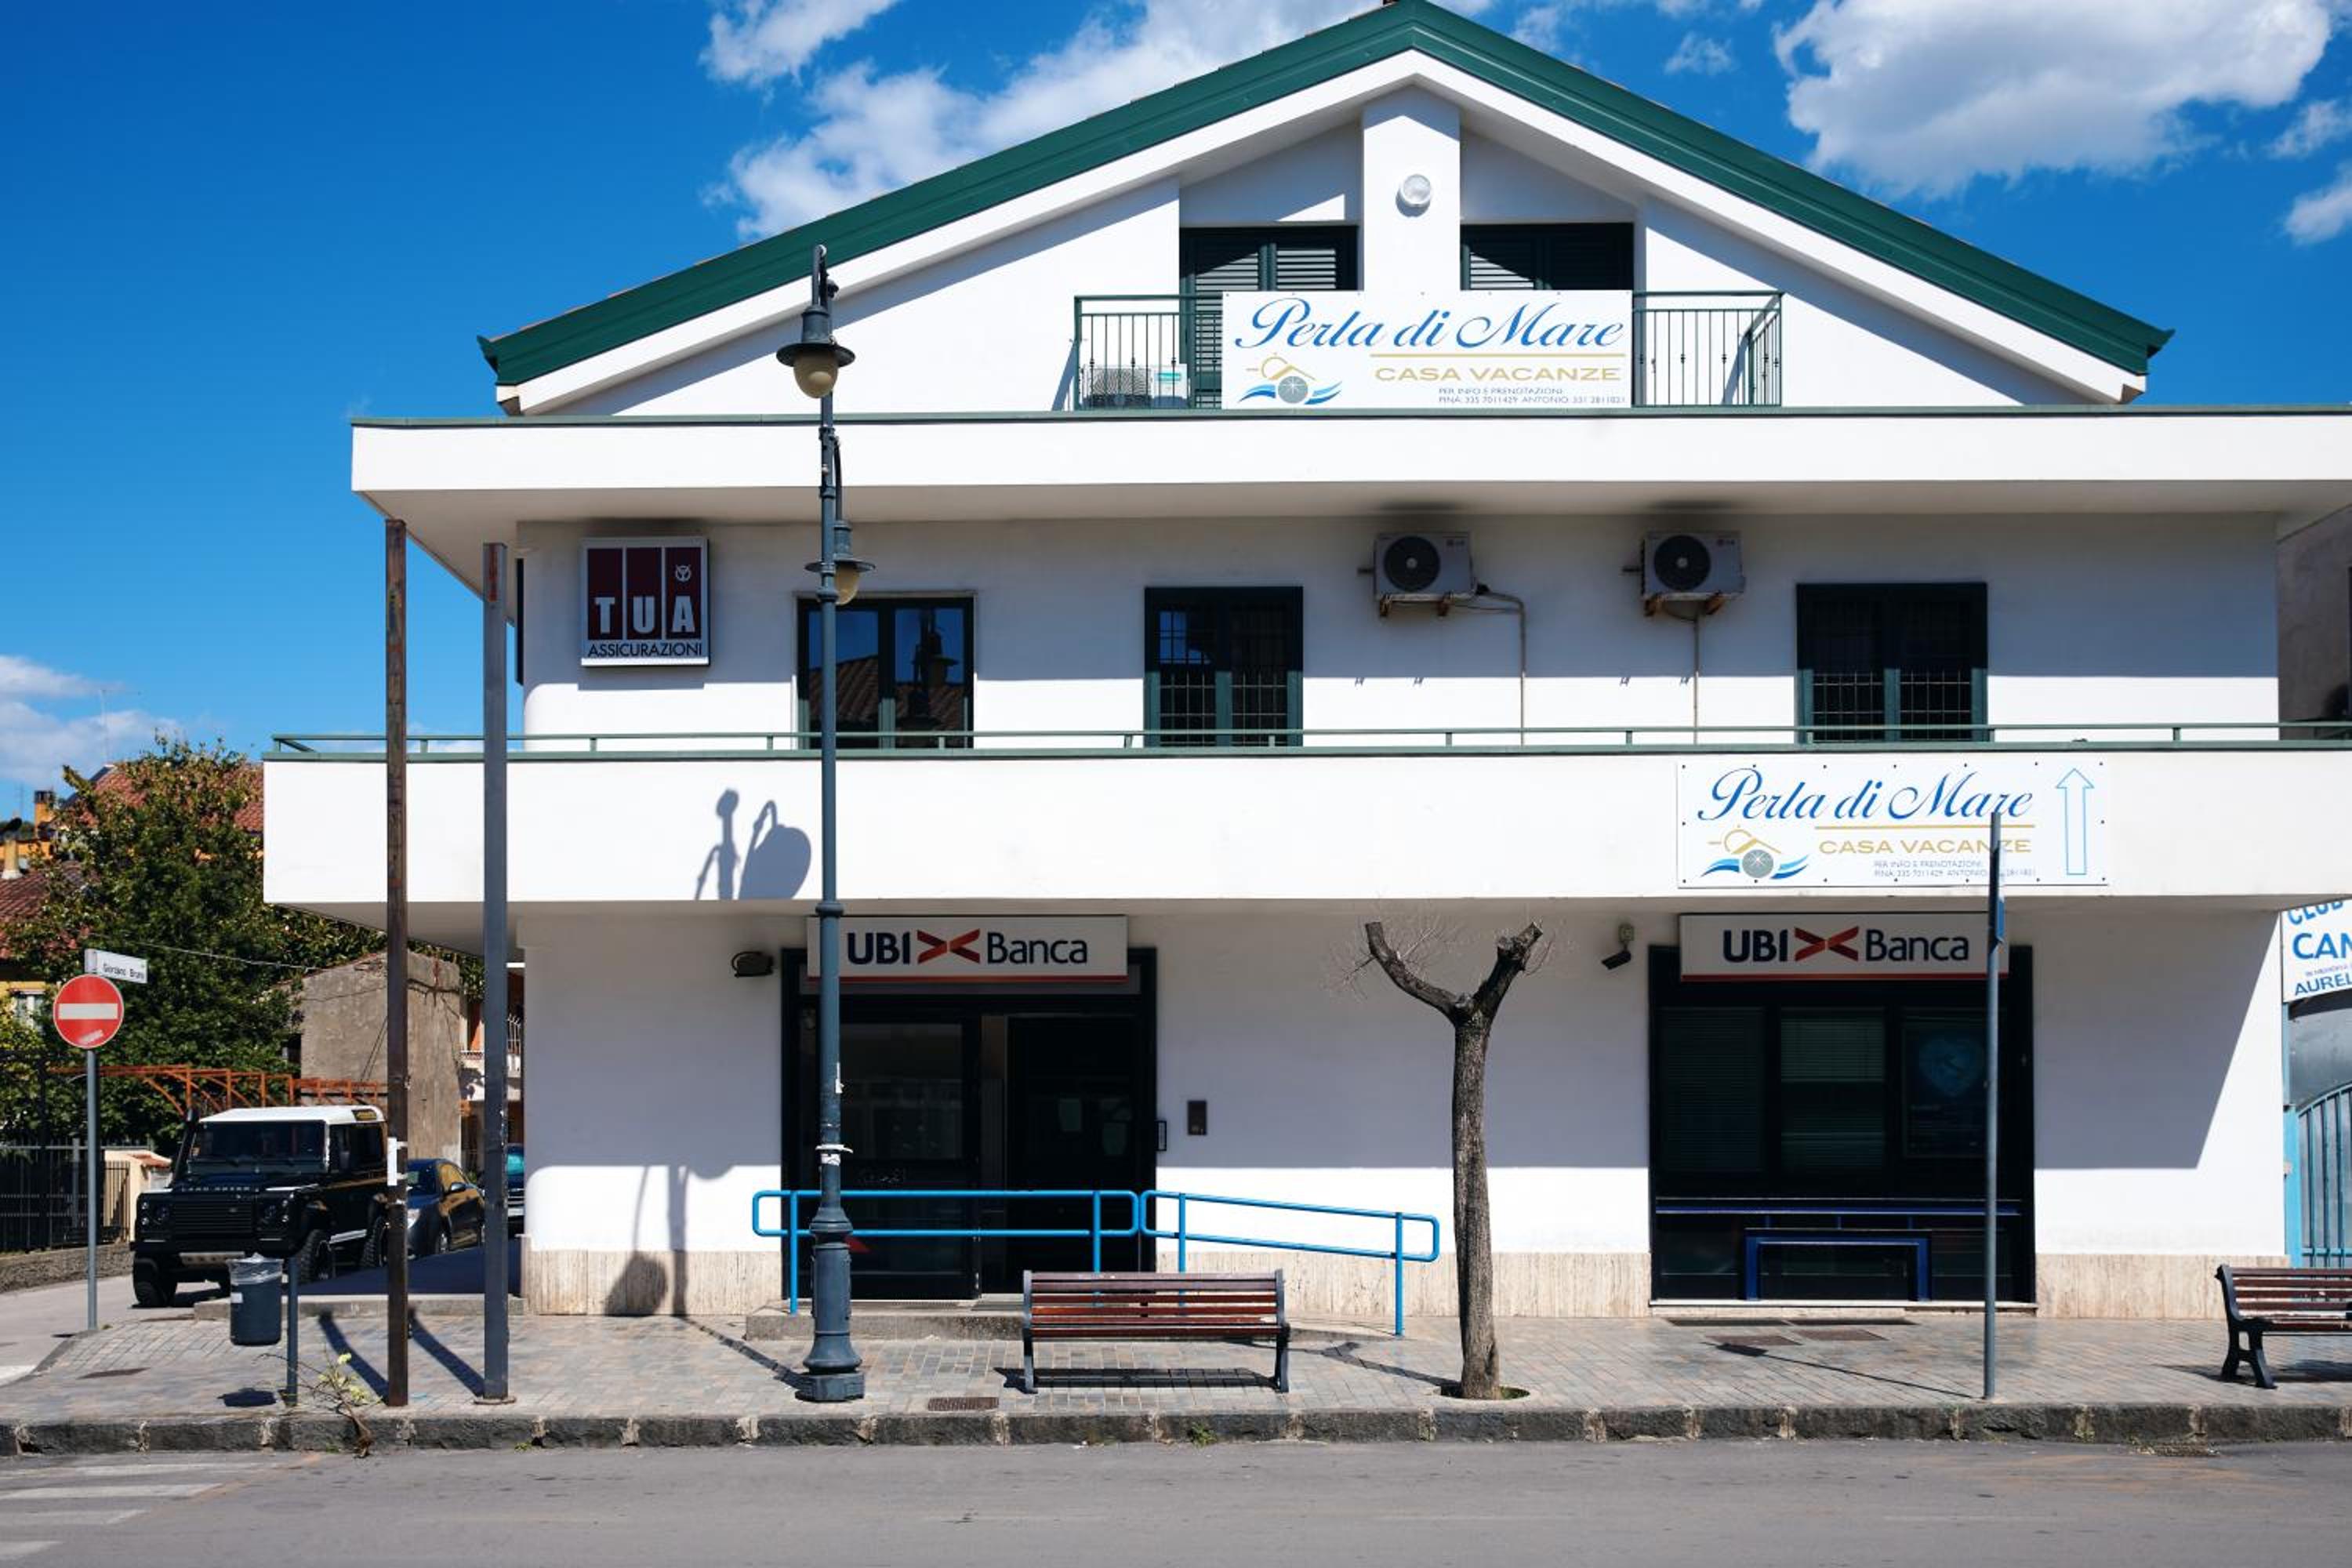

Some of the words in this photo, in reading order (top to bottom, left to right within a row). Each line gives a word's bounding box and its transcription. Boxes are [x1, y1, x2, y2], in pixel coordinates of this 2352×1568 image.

[1235, 297, 1388, 348] Perla
[1393, 310, 1451, 348] di
[1456, 301, 1625, 348] Mare
[1374, 367, 1465, 381] CASA
[1471, 367, 1620, 381] VACANZE
[594, 595, 696, 634] TUA
[588, 643, 702, 657] ASSICURAZIONI
[1697, 767, 1827, 820] Perla
[1834, 779, 1883, 819] di
[1887, 769, 2034, 819] Mare
[1819, 839, 1897, 854] CASA
[1900, 839, 2031, 854] VACANZE
[847, 931, 910, 965] UBI
[987, 931, 1088, 964] Banca
[1722, 929, 1788, 963] UBI
[1865, 929, 1969, 962] Banca
